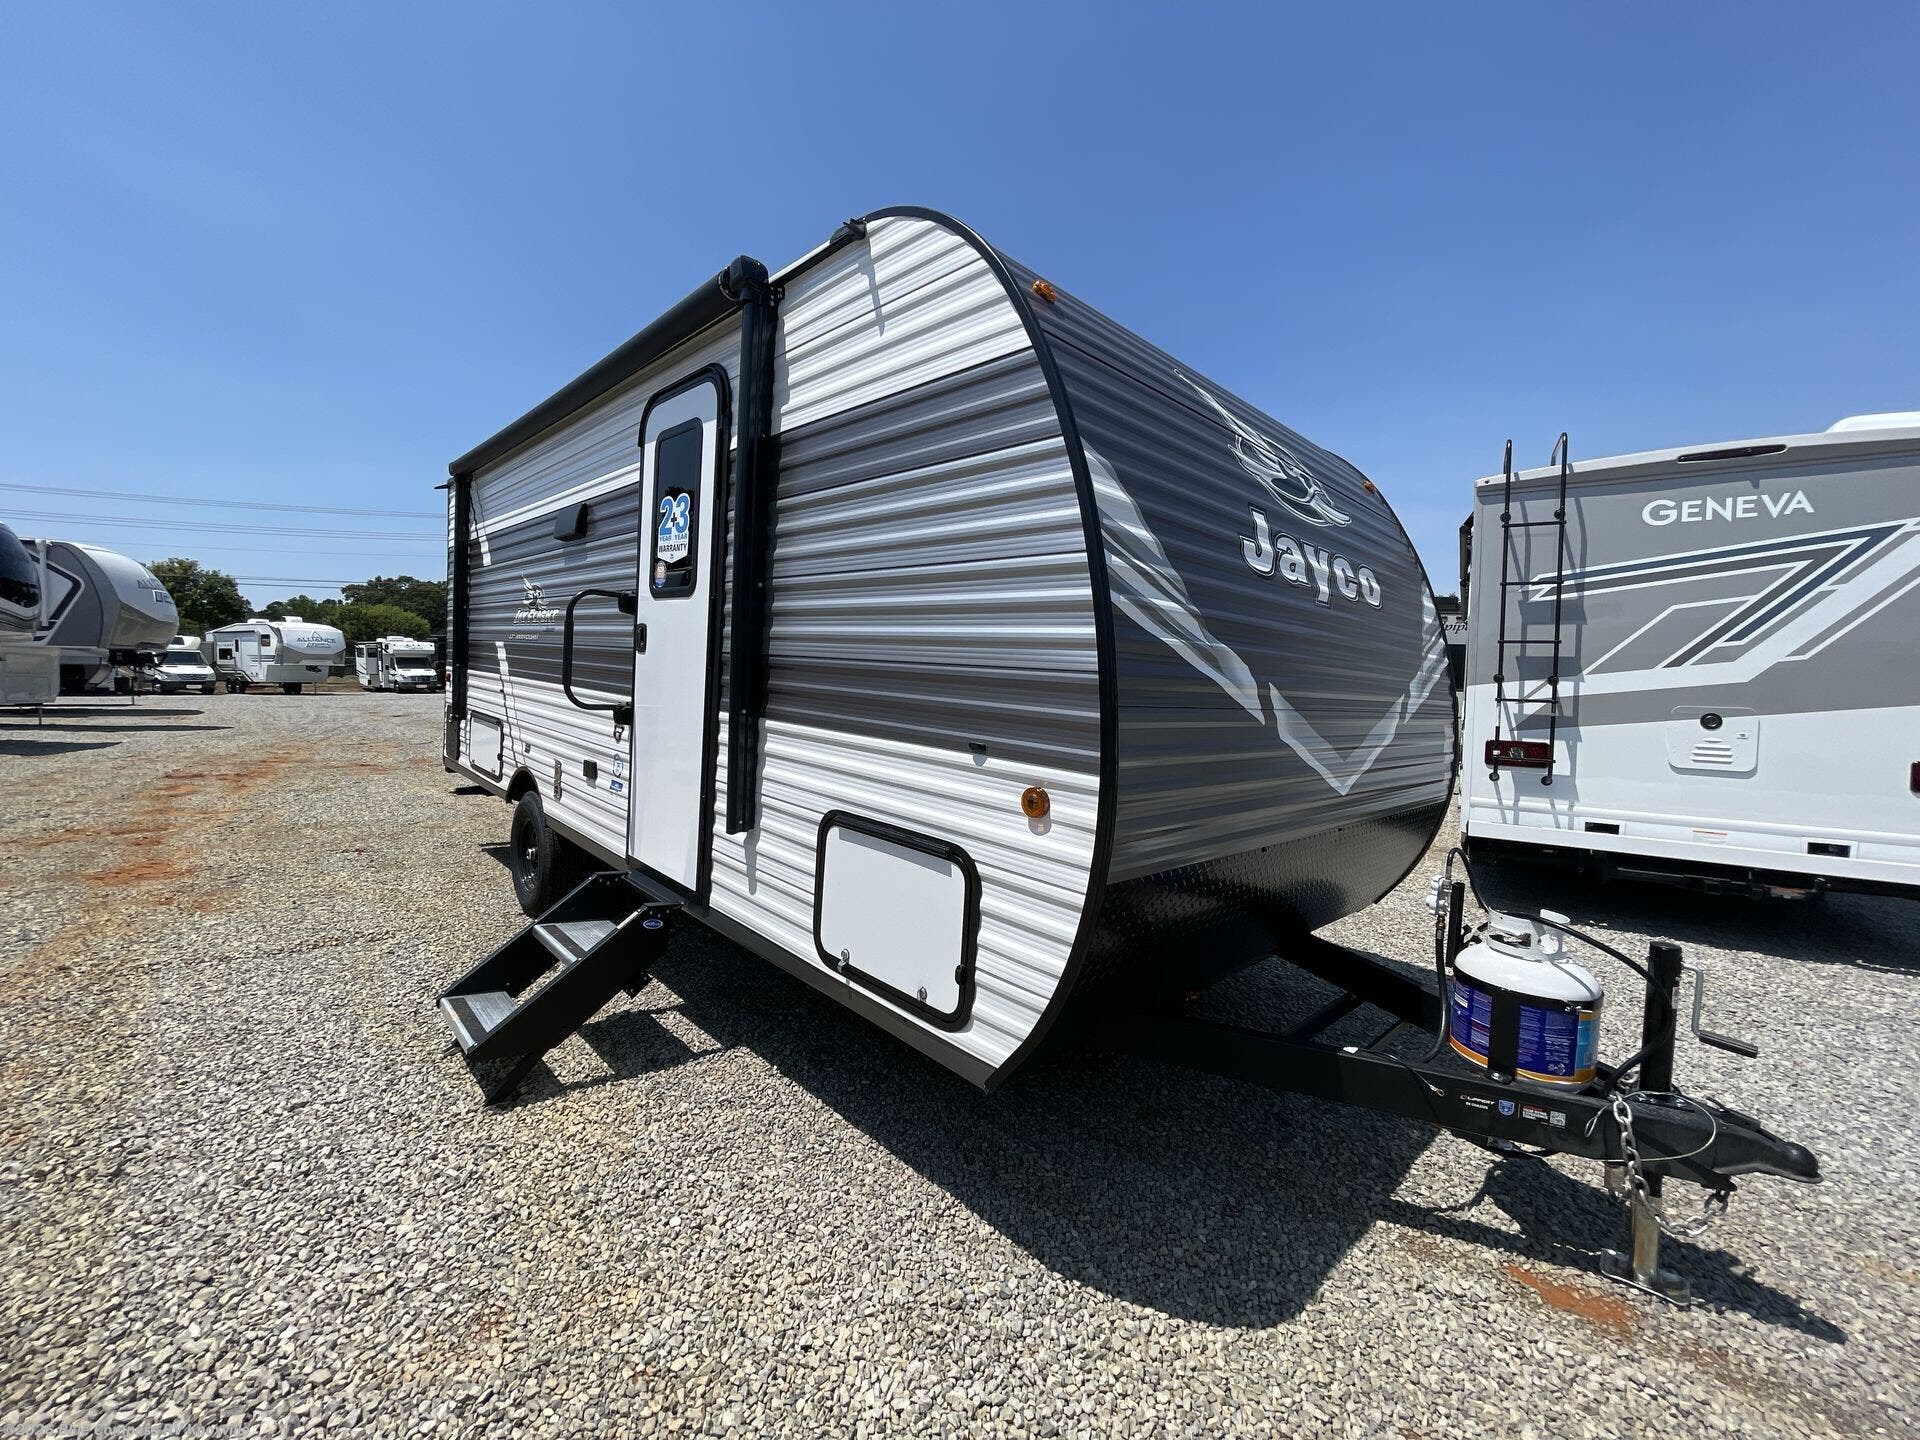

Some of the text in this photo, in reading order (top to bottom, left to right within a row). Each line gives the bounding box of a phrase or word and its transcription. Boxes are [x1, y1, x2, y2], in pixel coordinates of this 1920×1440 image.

[1641, 489, 1815, 526] GENEVA
[659, 543, 688, 552] WARRANTY
[1240, 506, 1382, 609] Jayco
